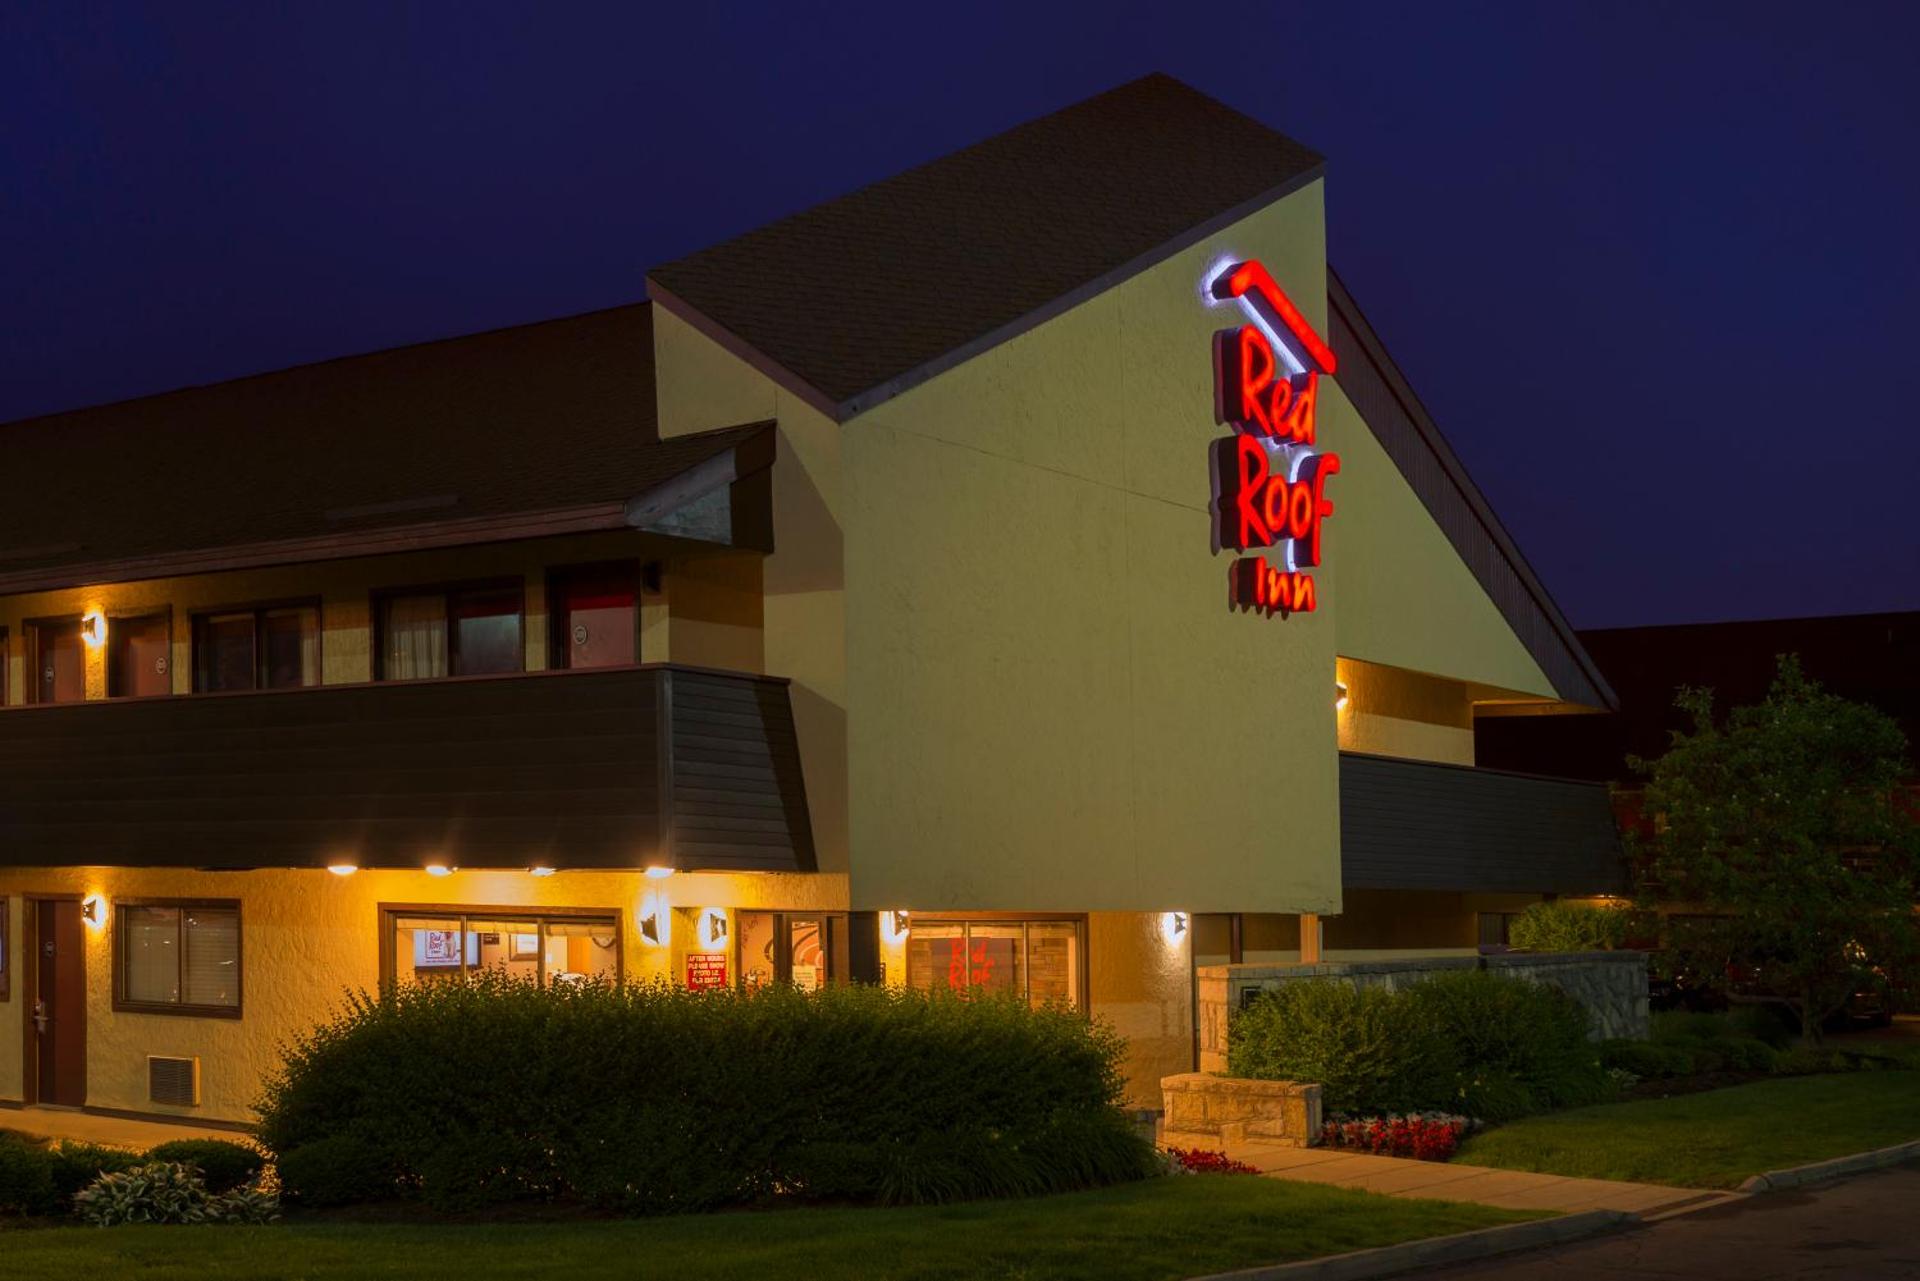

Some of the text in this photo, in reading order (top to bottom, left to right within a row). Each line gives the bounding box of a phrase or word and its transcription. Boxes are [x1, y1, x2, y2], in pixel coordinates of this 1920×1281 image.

[1240, 323, 1319, 446] Red
[1238, 432, 1341, 567] Roof
[1255, 555, 1317, 612] Inn
